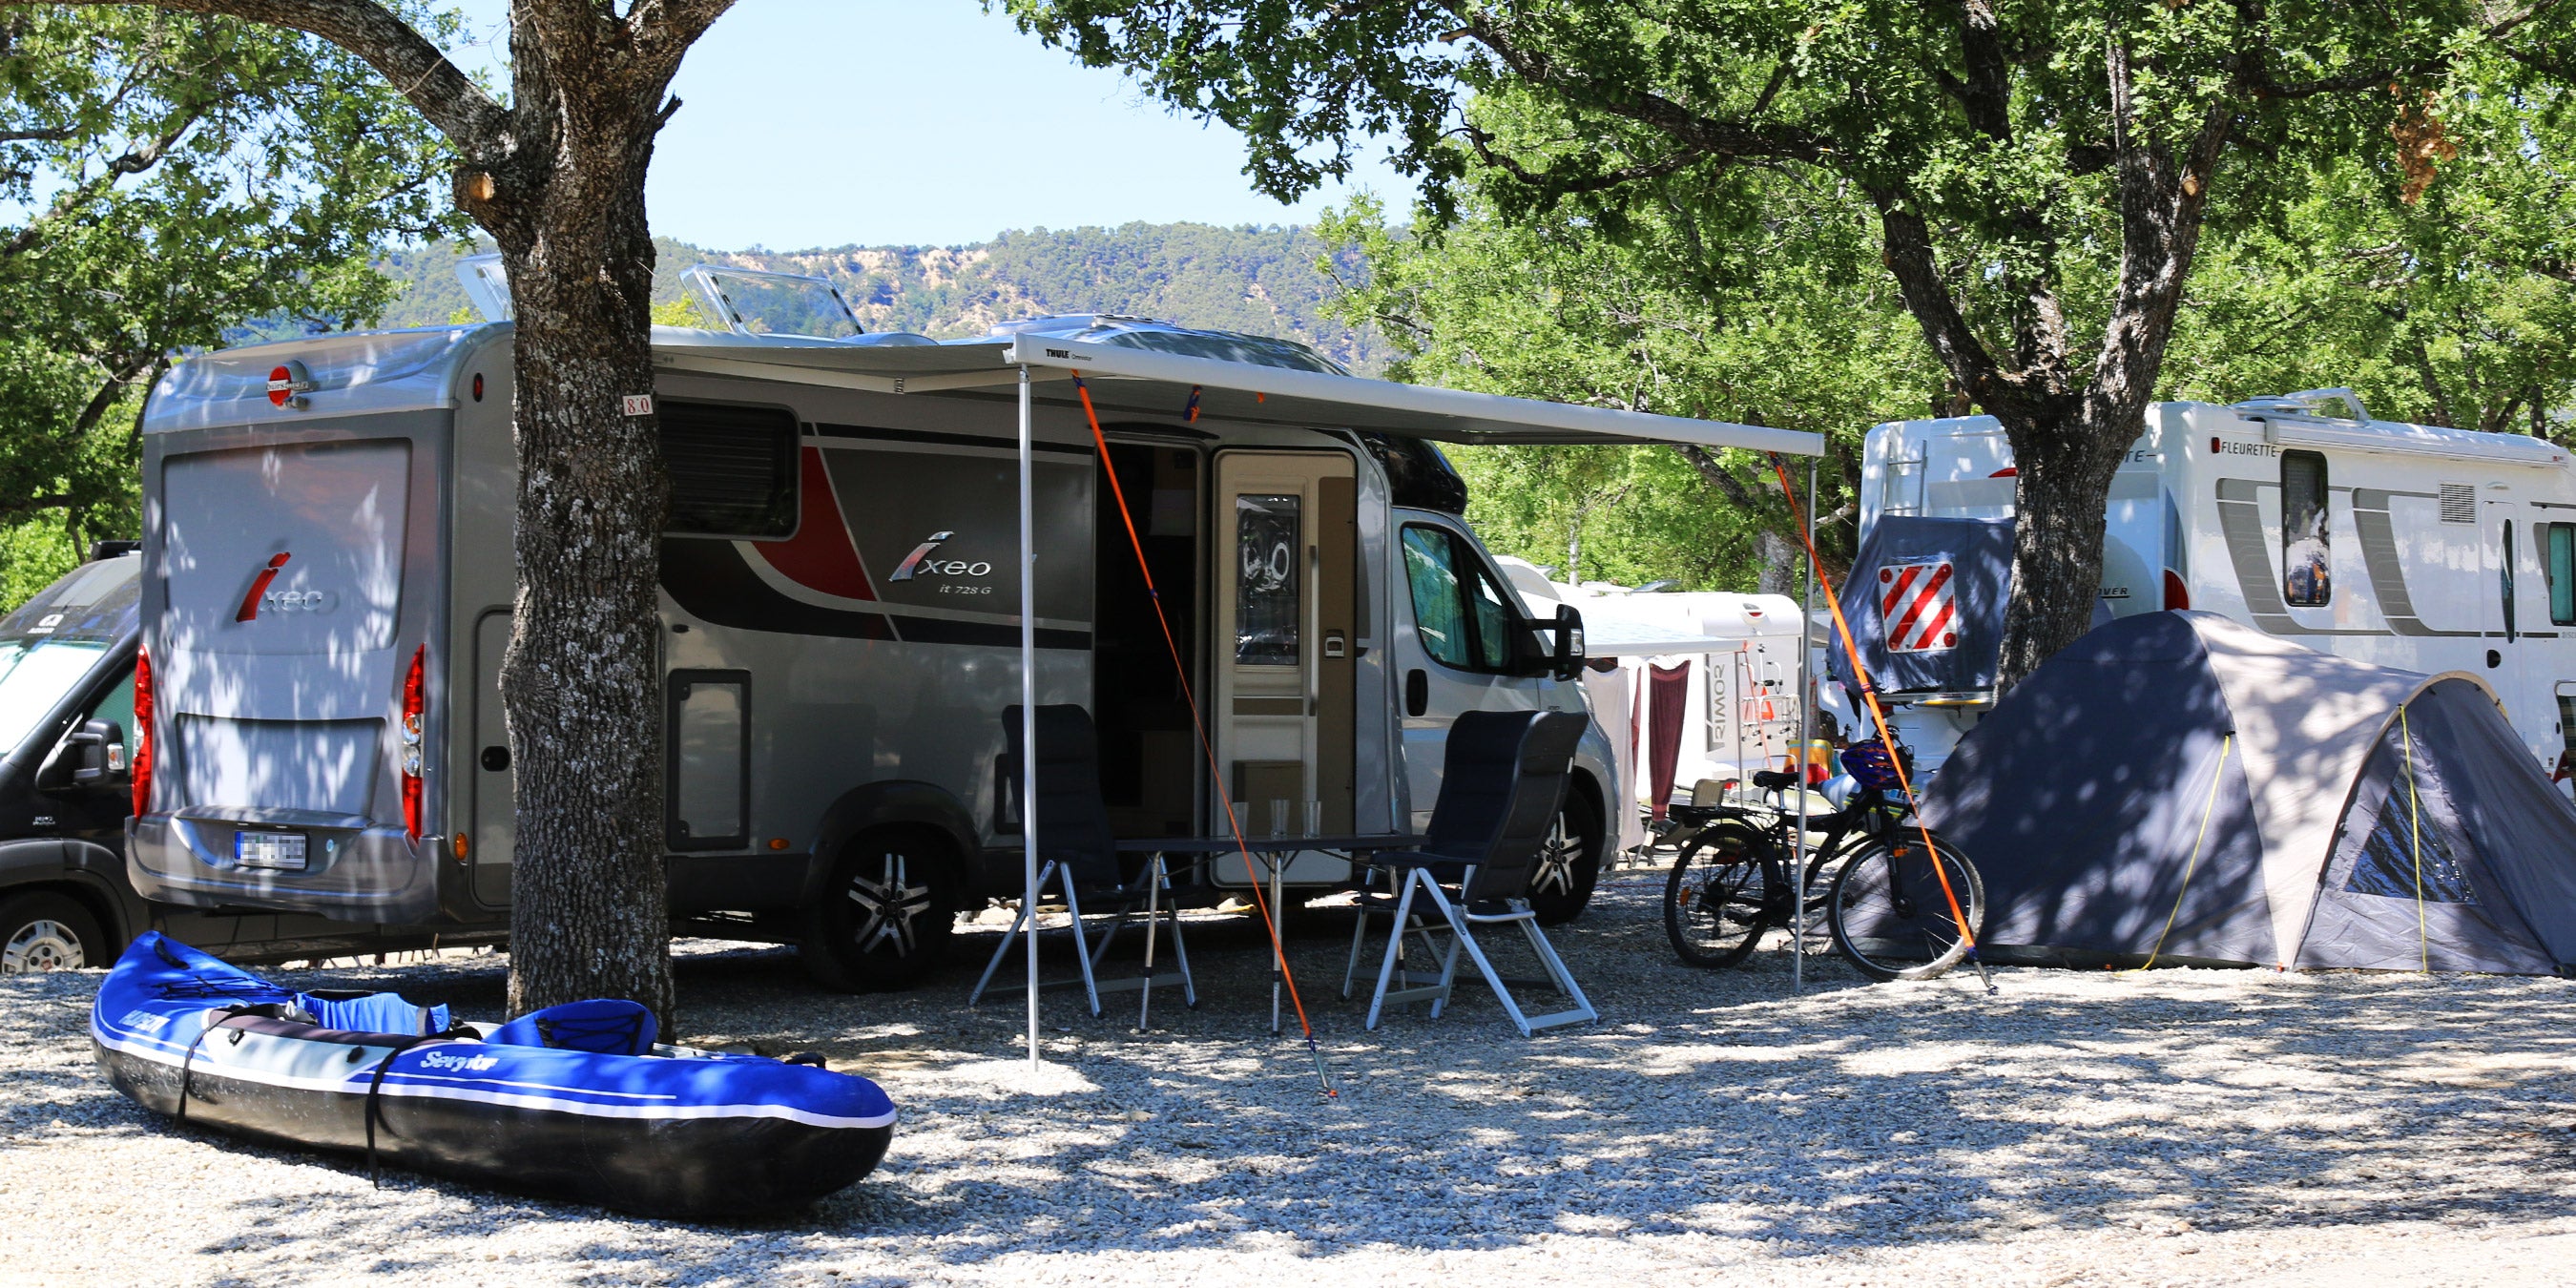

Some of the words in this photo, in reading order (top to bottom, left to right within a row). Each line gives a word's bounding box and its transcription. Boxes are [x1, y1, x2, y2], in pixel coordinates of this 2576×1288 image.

[1046, 348, 1069, 359] THULE
[2221, 441, 2276, 458] FLEURETTE
[955, 586, 978, 594] 728
[981, 586, 992, 594] G
